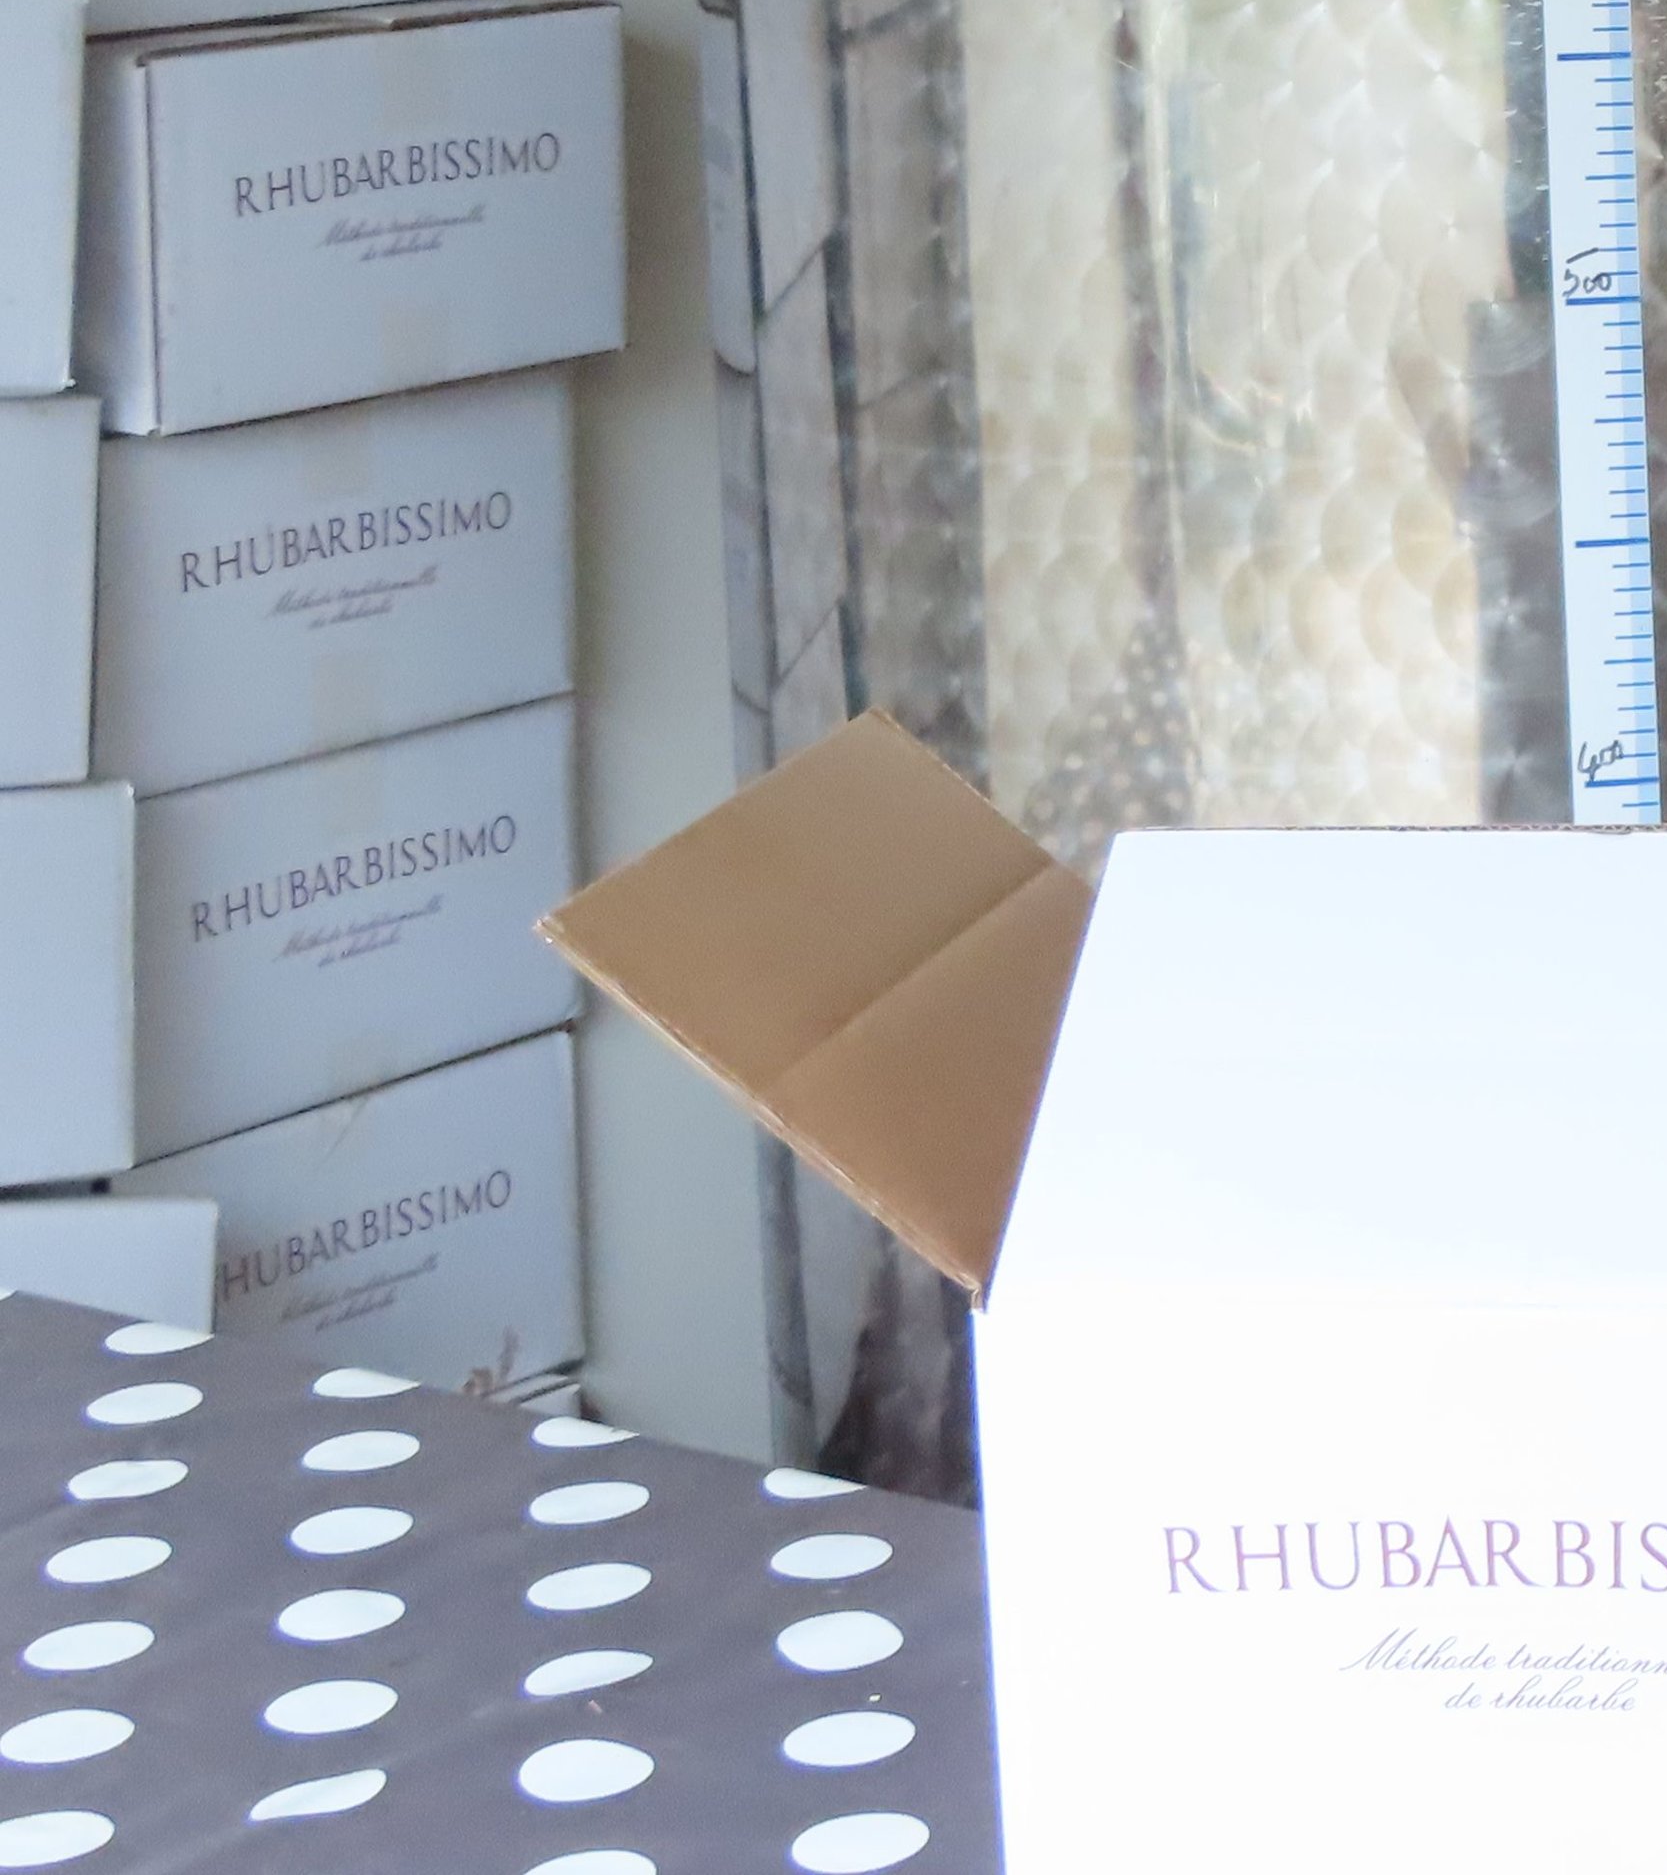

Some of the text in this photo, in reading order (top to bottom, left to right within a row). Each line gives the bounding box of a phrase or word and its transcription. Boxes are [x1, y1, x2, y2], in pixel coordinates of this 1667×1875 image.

[235, 132, 560, 217] RHUBARBISSIMO
[1562, 247, 1612, 297] 500
[180, 491, 511, 593] RHUBARBISSIMO
[190, 814, 517, 942] RHUBARBISSIMO
[217, 1169, 512, 1303] HUBARBISSIMO
[1338, 1627, 1498, 1672] Méthode
[1443, 1674, 1641, 1713] de rhubarbe
